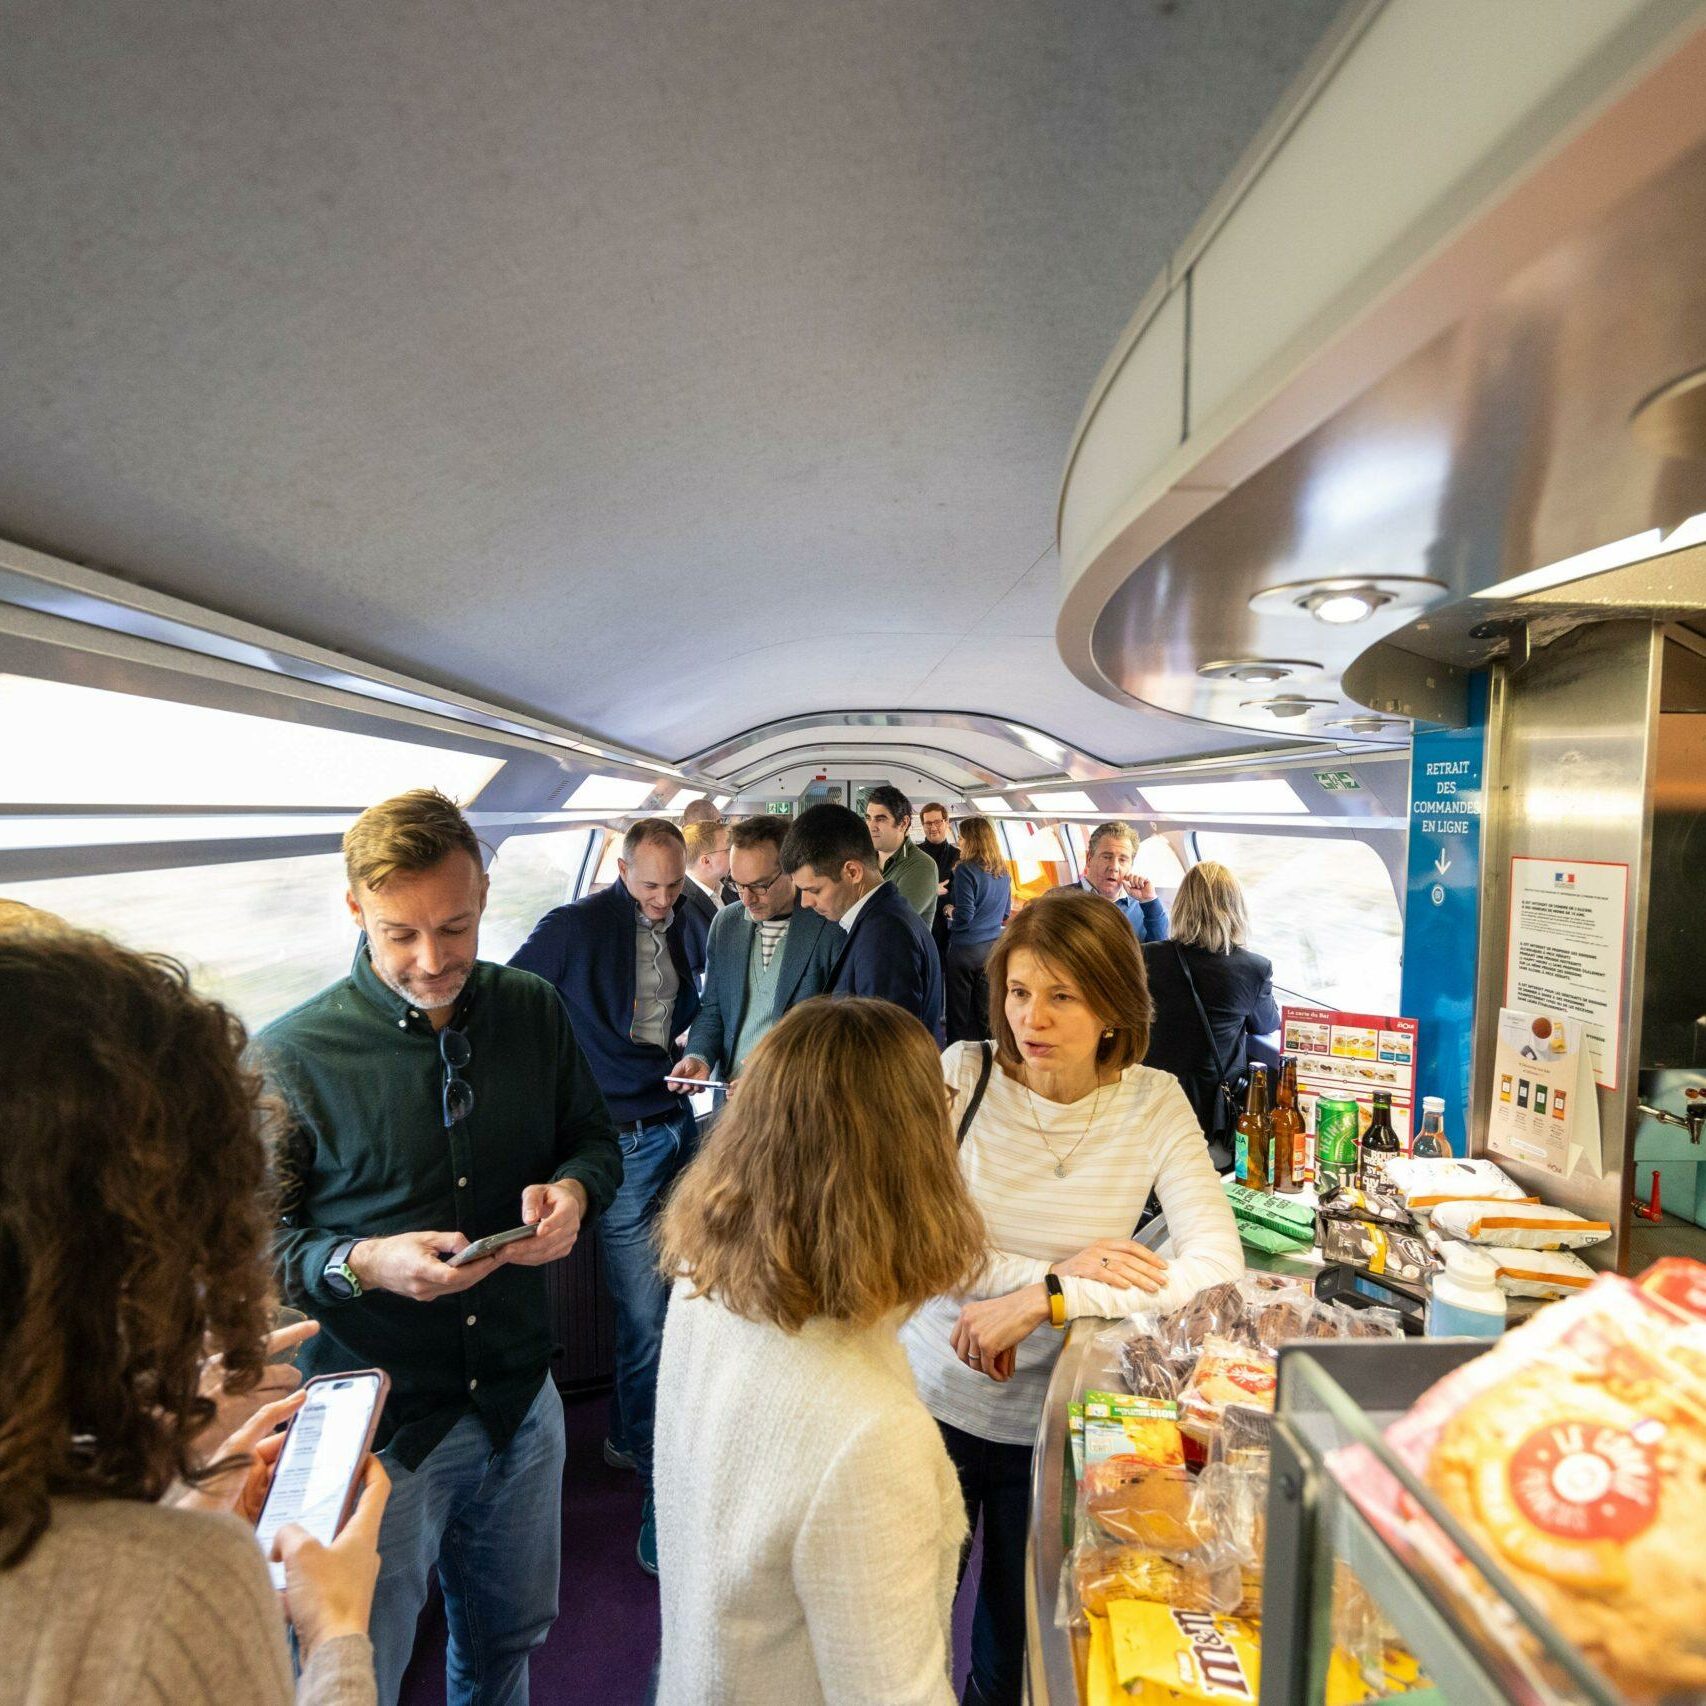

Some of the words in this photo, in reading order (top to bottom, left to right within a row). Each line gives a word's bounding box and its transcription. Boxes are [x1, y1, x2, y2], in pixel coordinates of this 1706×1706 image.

[1426, 761, 1470, 775] RETRAIT
[1436, 782, 1457, 794] DES
[1422, 820, 1435, 832] EN
[1437, 820, 1469, 834] LIGNE
